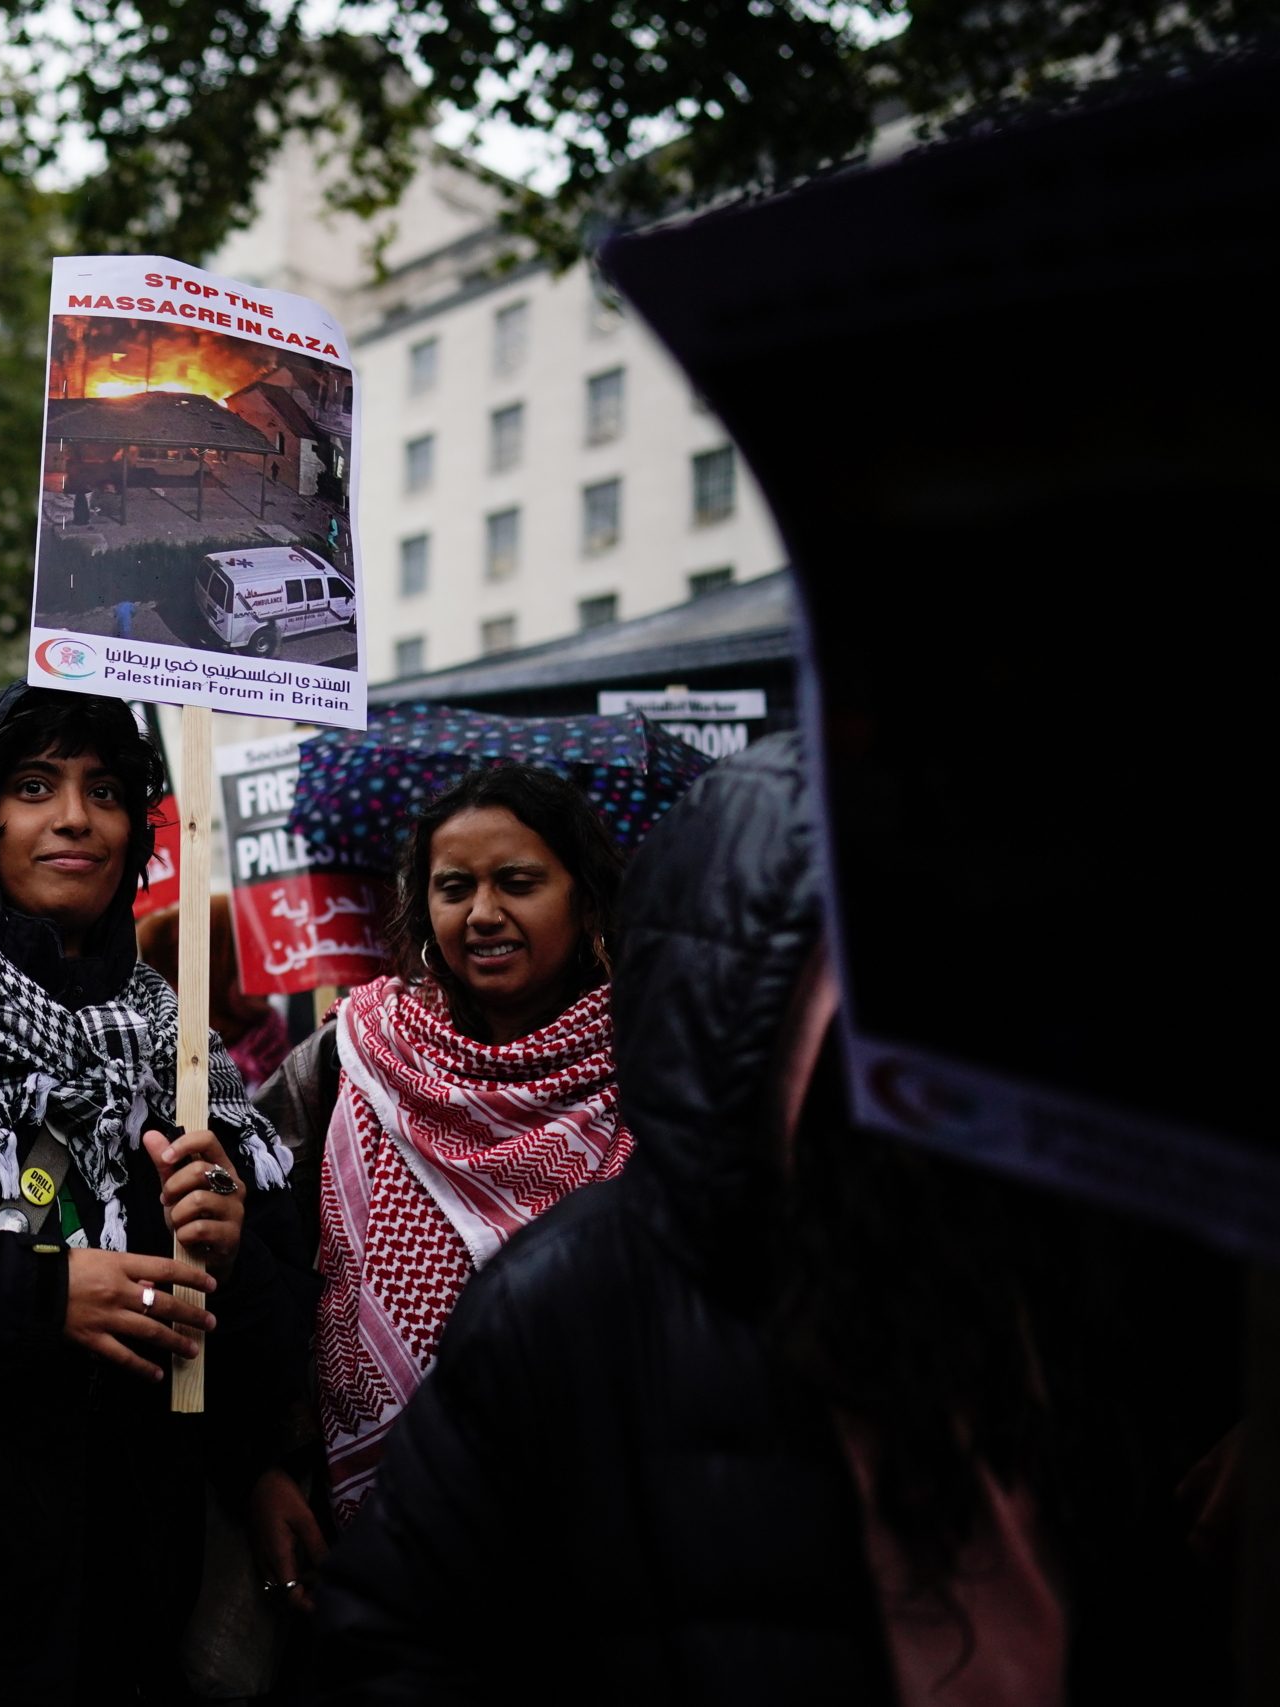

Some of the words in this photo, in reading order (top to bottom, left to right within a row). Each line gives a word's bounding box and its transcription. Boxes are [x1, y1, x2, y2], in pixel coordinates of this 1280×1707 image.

[144, 272, 219, 300] STOP
[224, 292, 274, 319] THE
[68, 295, 232, 328] MASSACRE
[237, 317, 262, 336] IN
[267, 327, 341, 359] GAZA
[252, 596, 283, 608] AMBULANCE
[104, 647, 161, 670] بريطانيا
[164, 658, 199, 674] في
[202, 660, 292, 686] الفلسطيني
[104, 665, 202, 693] Palestinian
[208, 680, 264, 701] Forum
[269, 688, 285, 702] in
[291, 690, 350, 712] Britain
[26, 1181, 44, 1203] KILL
[30, 1170, 53, 1194] DRILL
